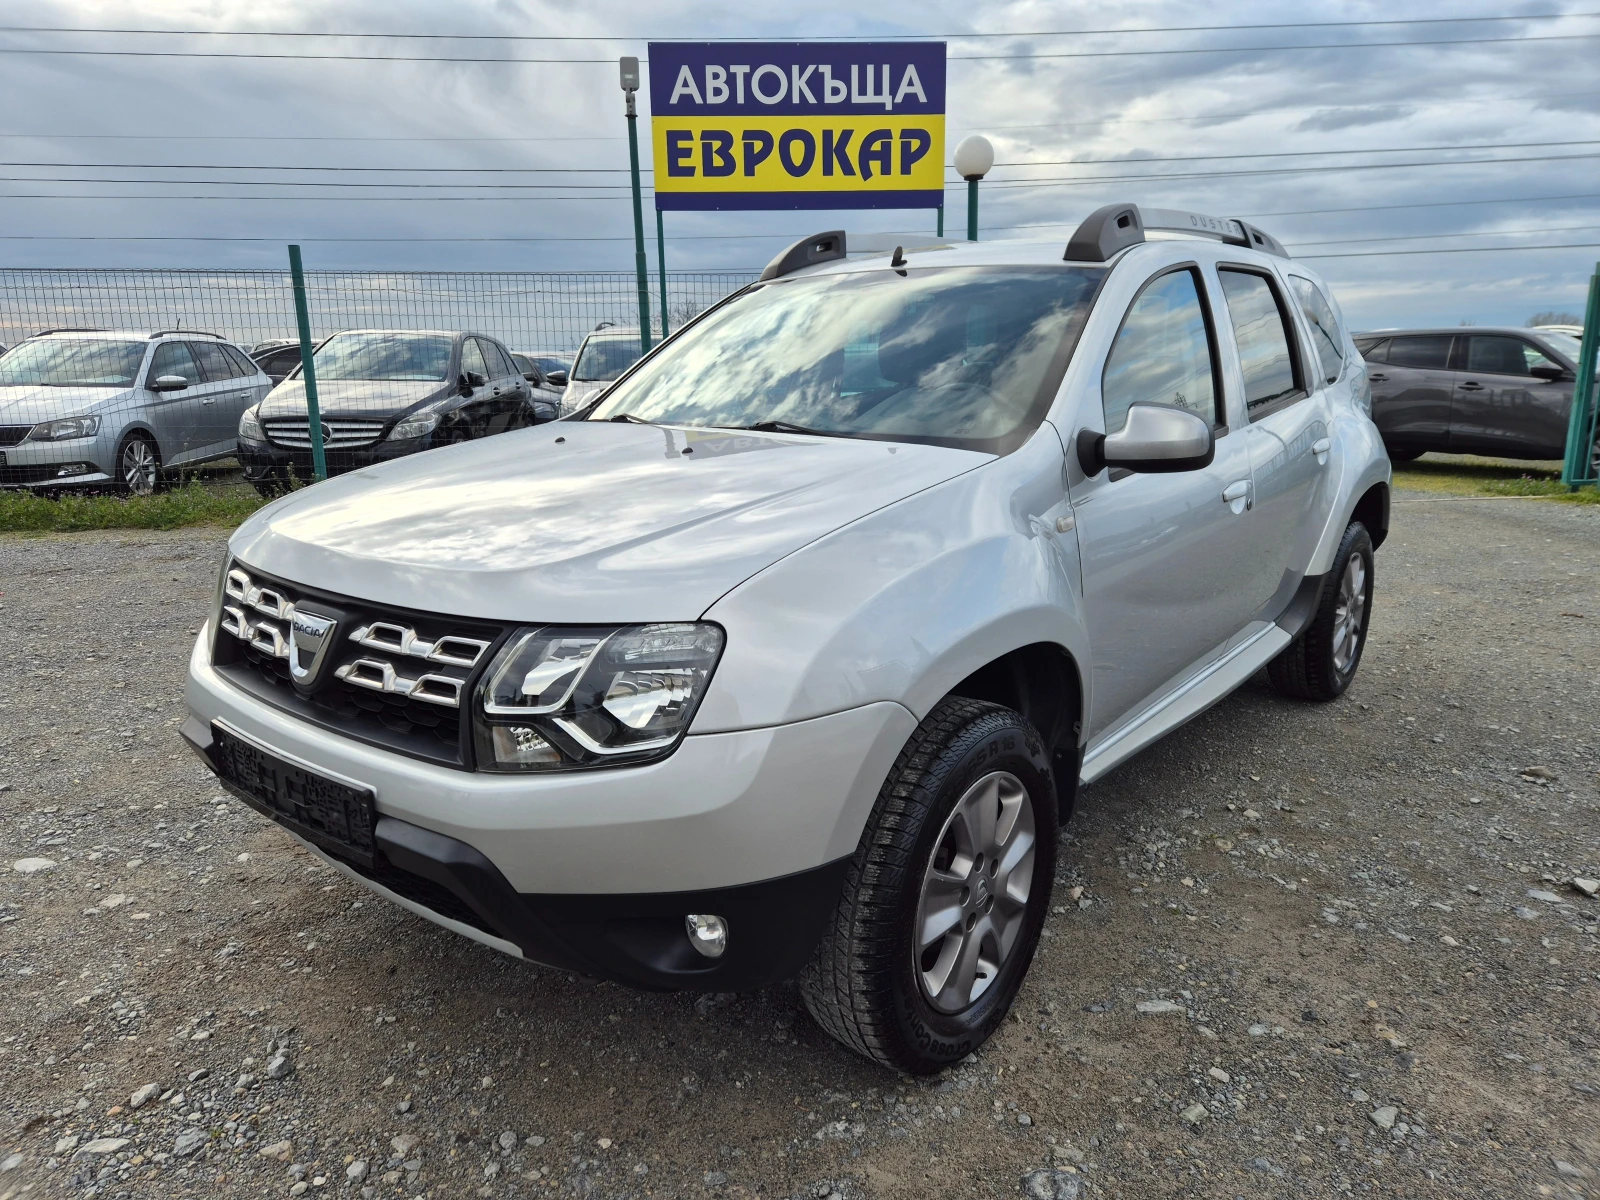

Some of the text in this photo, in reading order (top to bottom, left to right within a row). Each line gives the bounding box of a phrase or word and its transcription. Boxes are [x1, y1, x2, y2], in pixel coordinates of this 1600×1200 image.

[669, 63, 928, 110] АВТОКЪЩА
[666, 128, 931, 182] ЕВРОКАР
[1190, 215, 1241, 235] DUSTER
[293, 621, 321, 638] DACIA
